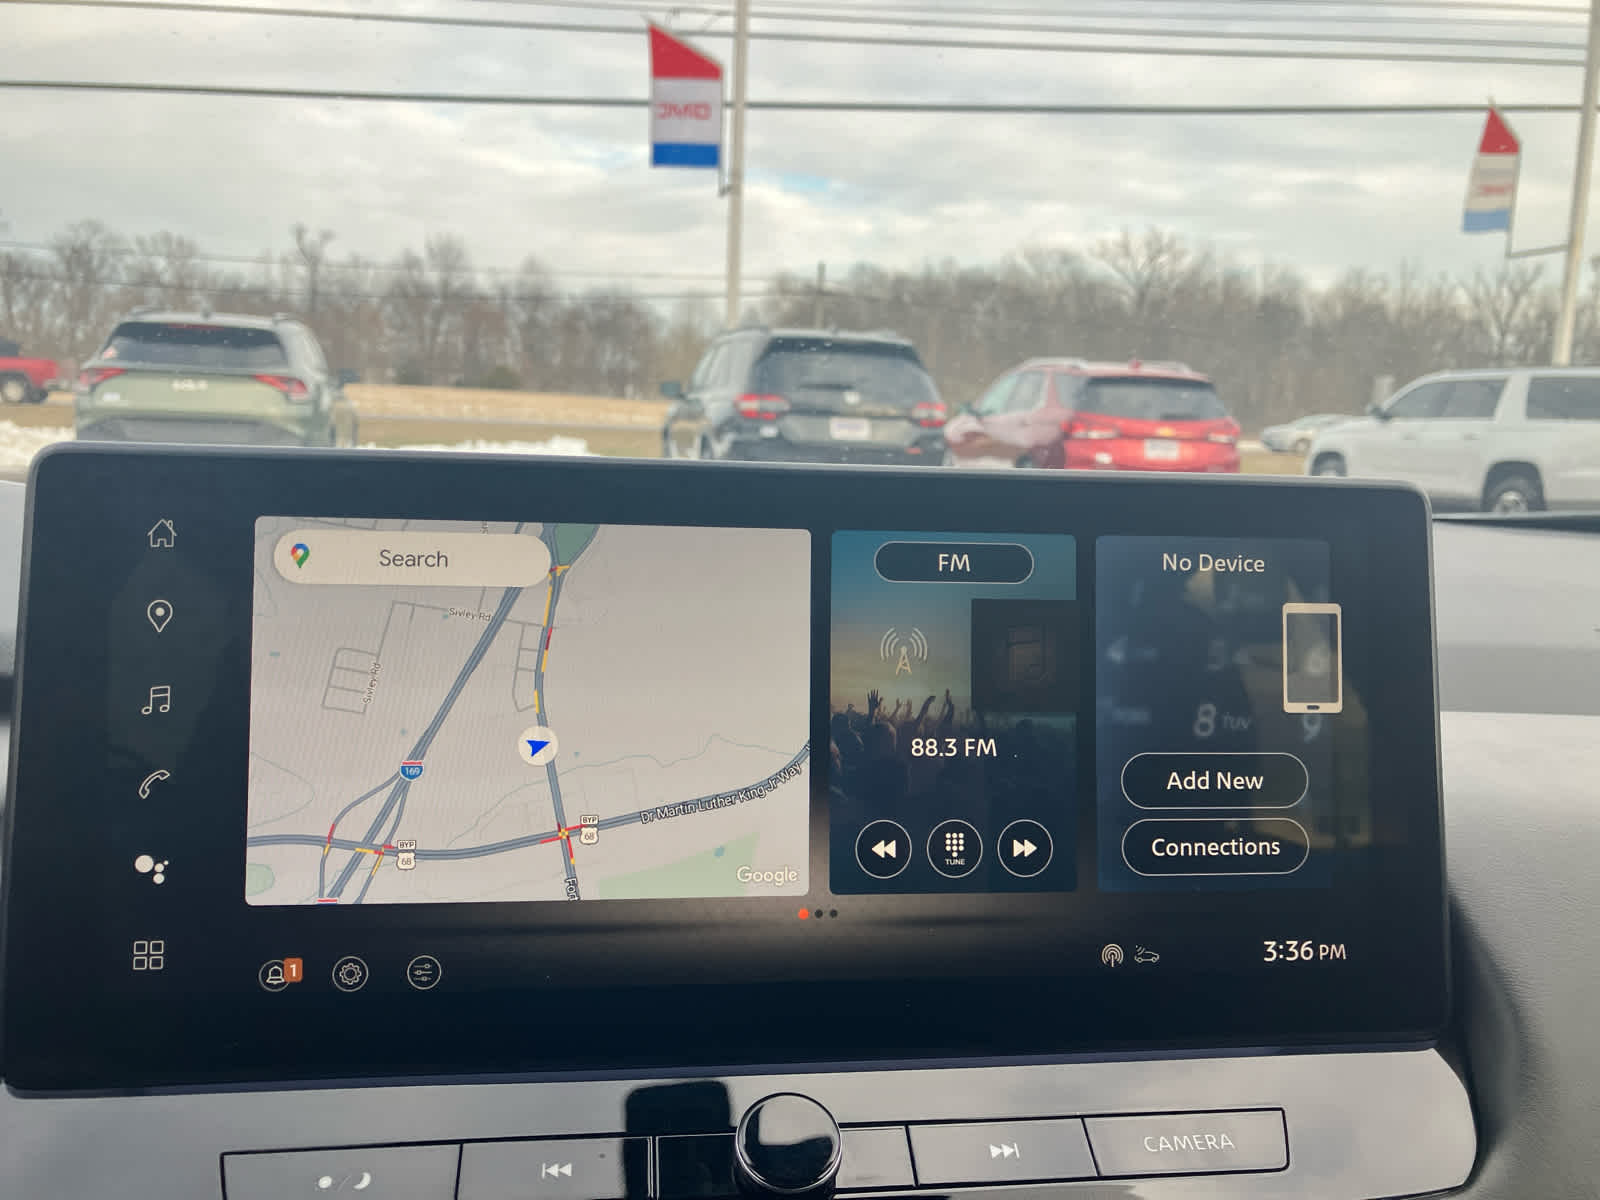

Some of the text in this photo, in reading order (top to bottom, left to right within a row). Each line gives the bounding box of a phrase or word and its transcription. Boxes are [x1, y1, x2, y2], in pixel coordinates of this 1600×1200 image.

[379, 549, 449, 568] Search
[938, 553, 971, 573] FM
[1162, 552, 1265, 573] No Device
[449, 607, 491, 622] Sivley Rd
[363, 663, 381, 703] Sivley Rd
[911, 738, 997, 757] 88.3 FM
[405, 766, 420, 776] 169
[1166, 771, 1264, 790] Add New
[641, 761, 802, 824] Dr Martin Luther King Jr Way
[582, 815, 598, 825] BYP
[399, 840, 416, 849] BYP
[584, 832, 595, 841] 68
[1151, 837, 1281, 857] Connections
[401, 857, 412, 866] 68
[945, 858, 966, 866] TUNE
[736, 866, 798, 886] Google
[1263, 940, 1347, 962] 3:36 PM
[1143, 1133, 1235, 1154] CAMERA
